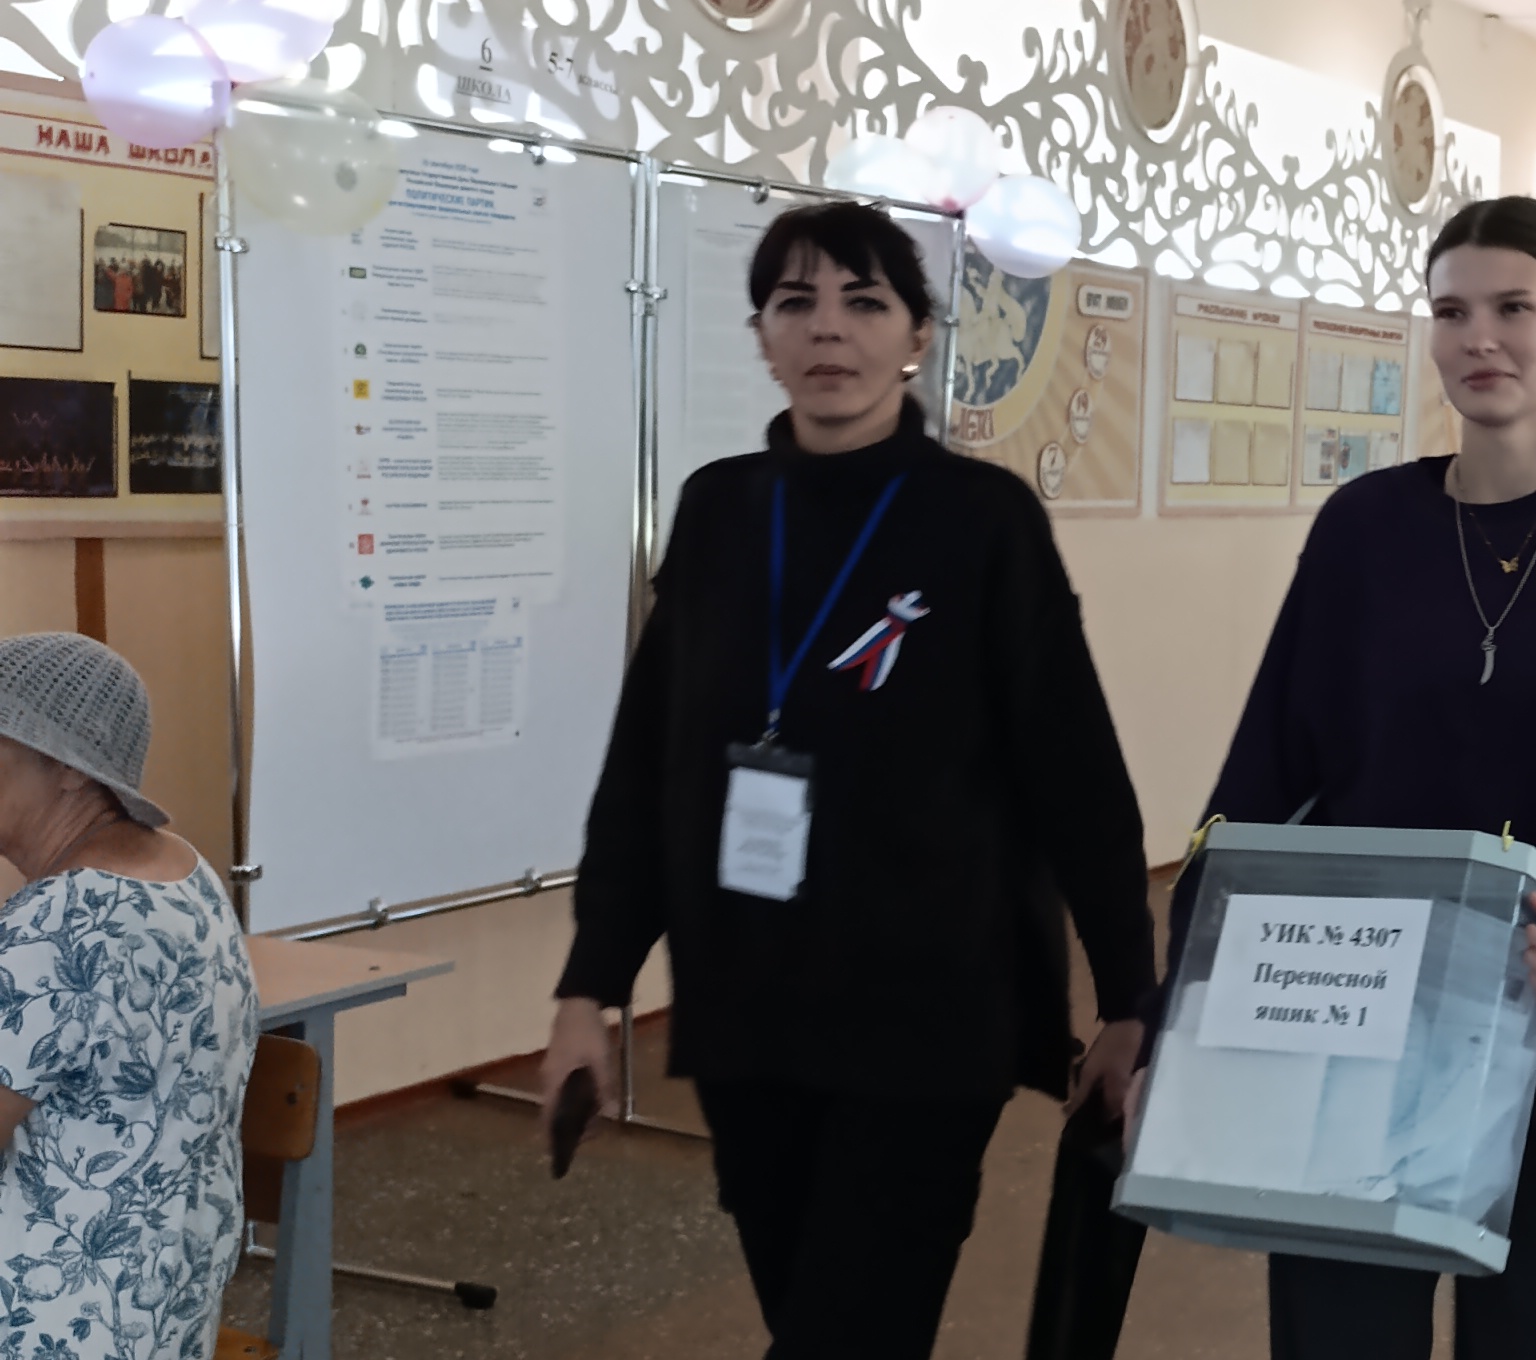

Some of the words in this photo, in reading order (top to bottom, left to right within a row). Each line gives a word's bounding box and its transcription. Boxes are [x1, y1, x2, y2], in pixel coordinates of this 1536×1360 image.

[480, 38, 493, 65] 6
[547, 51, 575, 80] 5-7
[455, 74, 513, 102] ШКОЛА
[35, 123, 111, 156] НАША
[1260, 922, 1316, 944] УИК
[1316, 924, 1345, 946] №
[1349, 926, 1403, 948] 4307
[1252, 962, 1389, 990] Переносной
[1321, 1004, 1350, 1026] №
[1356, 1005, 1368, 1027] 1
